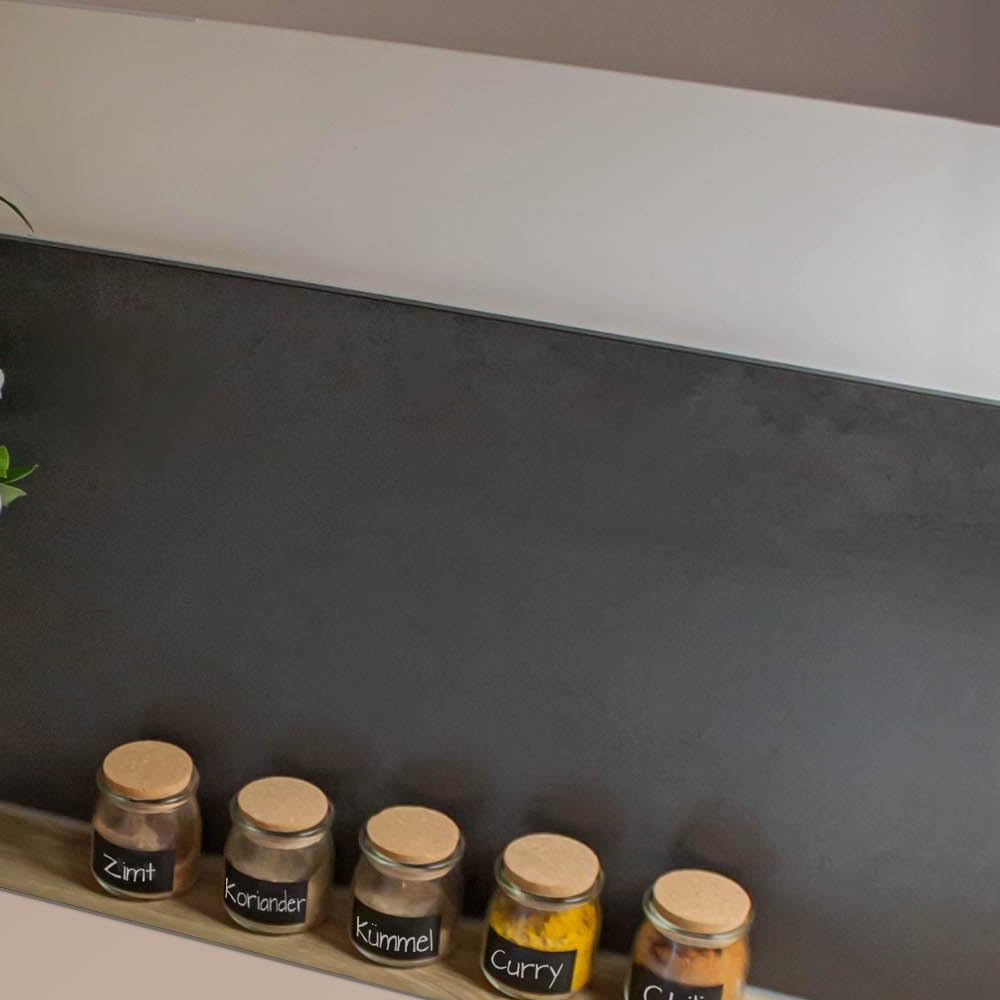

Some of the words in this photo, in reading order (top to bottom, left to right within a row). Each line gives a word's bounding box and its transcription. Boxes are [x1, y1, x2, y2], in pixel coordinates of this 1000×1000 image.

[102, 853, 157, 882] Zimt
[224, 877, 307, 913] Koriander
[355, 915, 434, 953] Kümmel
[490, 949, 564, 990] Curry
